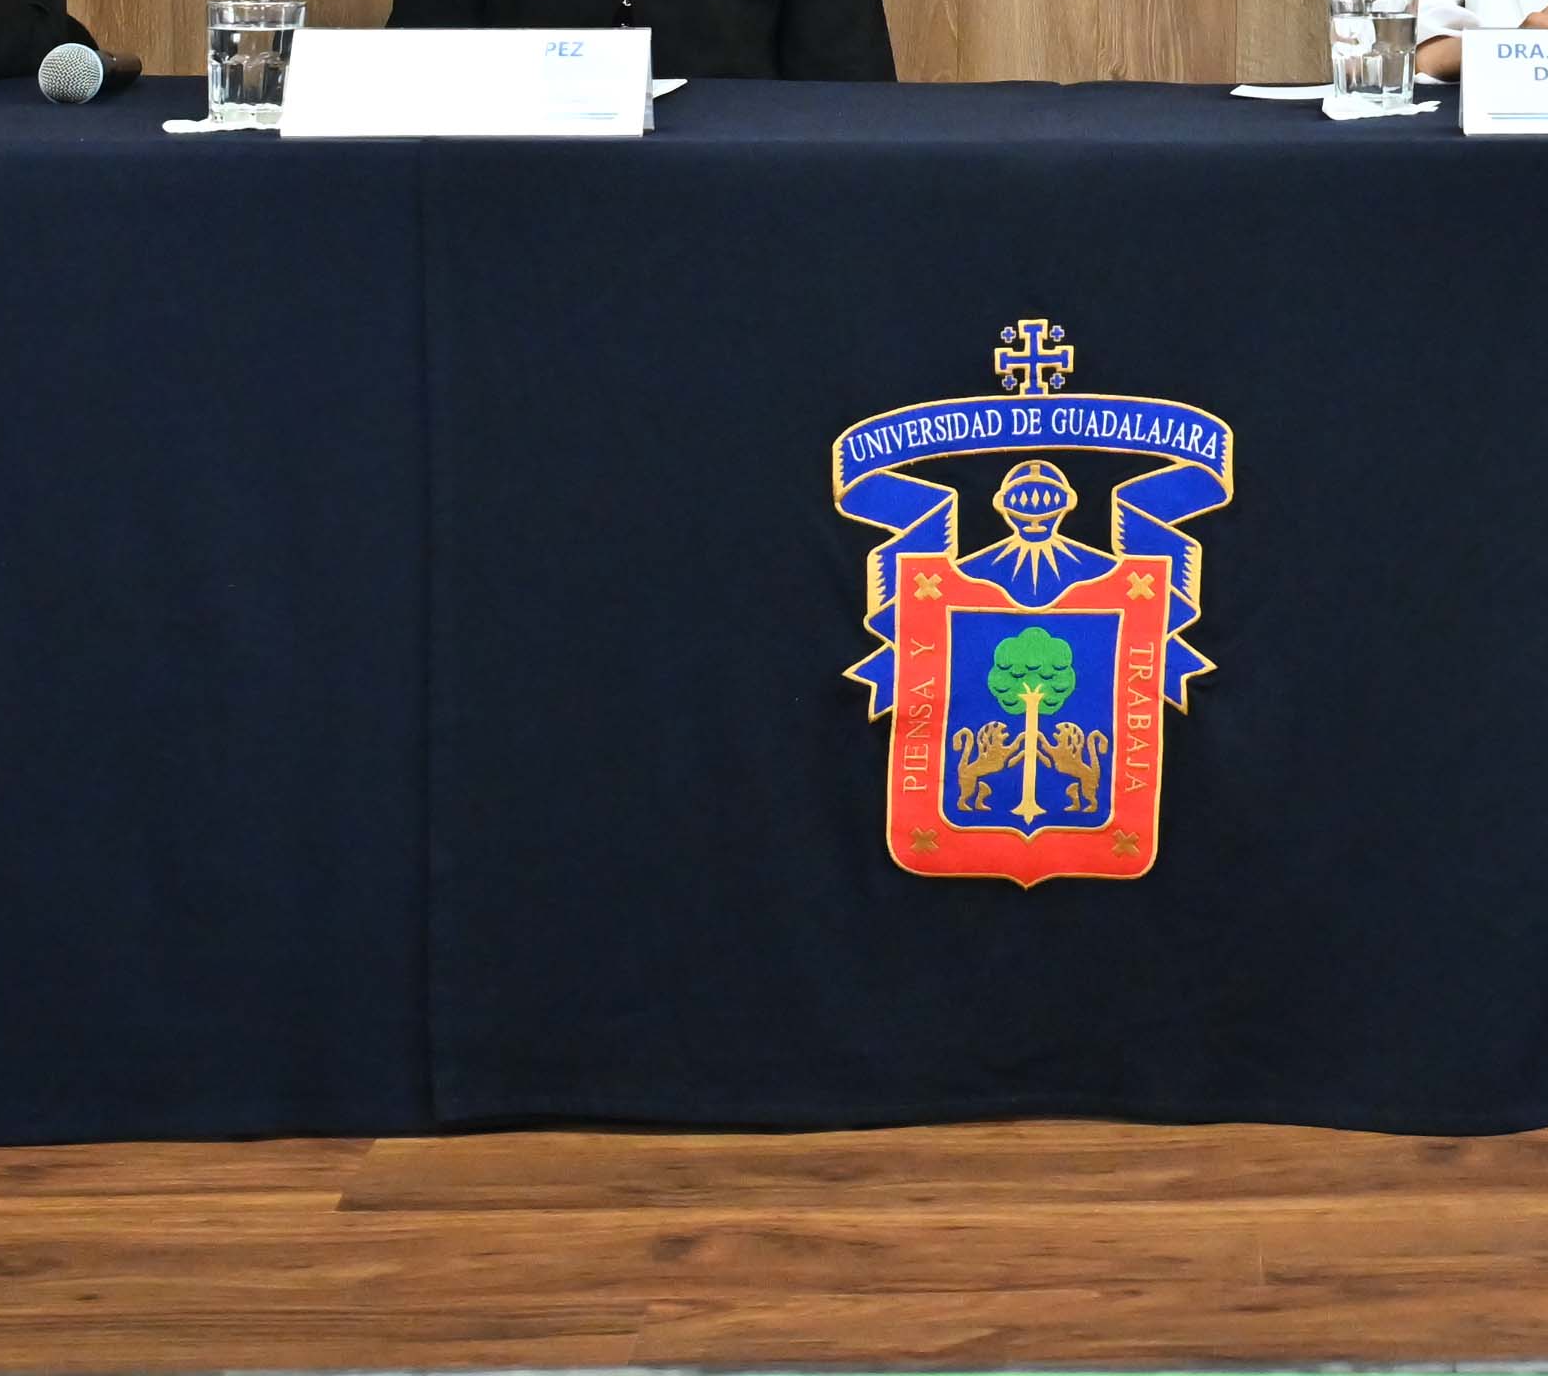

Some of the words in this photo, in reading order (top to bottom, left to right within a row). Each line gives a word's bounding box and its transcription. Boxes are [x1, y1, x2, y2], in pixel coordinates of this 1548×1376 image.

[848, 407, 1003, 462] UNIVERSIDAD
[1011, 409, 1042, 435] DE
[1052, 407, 1220, 461] GUADALAJARA
[909, 638, 936, 656] Y
[903, 677, 935, 793] PIENSA
[1127, 642, 1154, 794] TRABAJA
